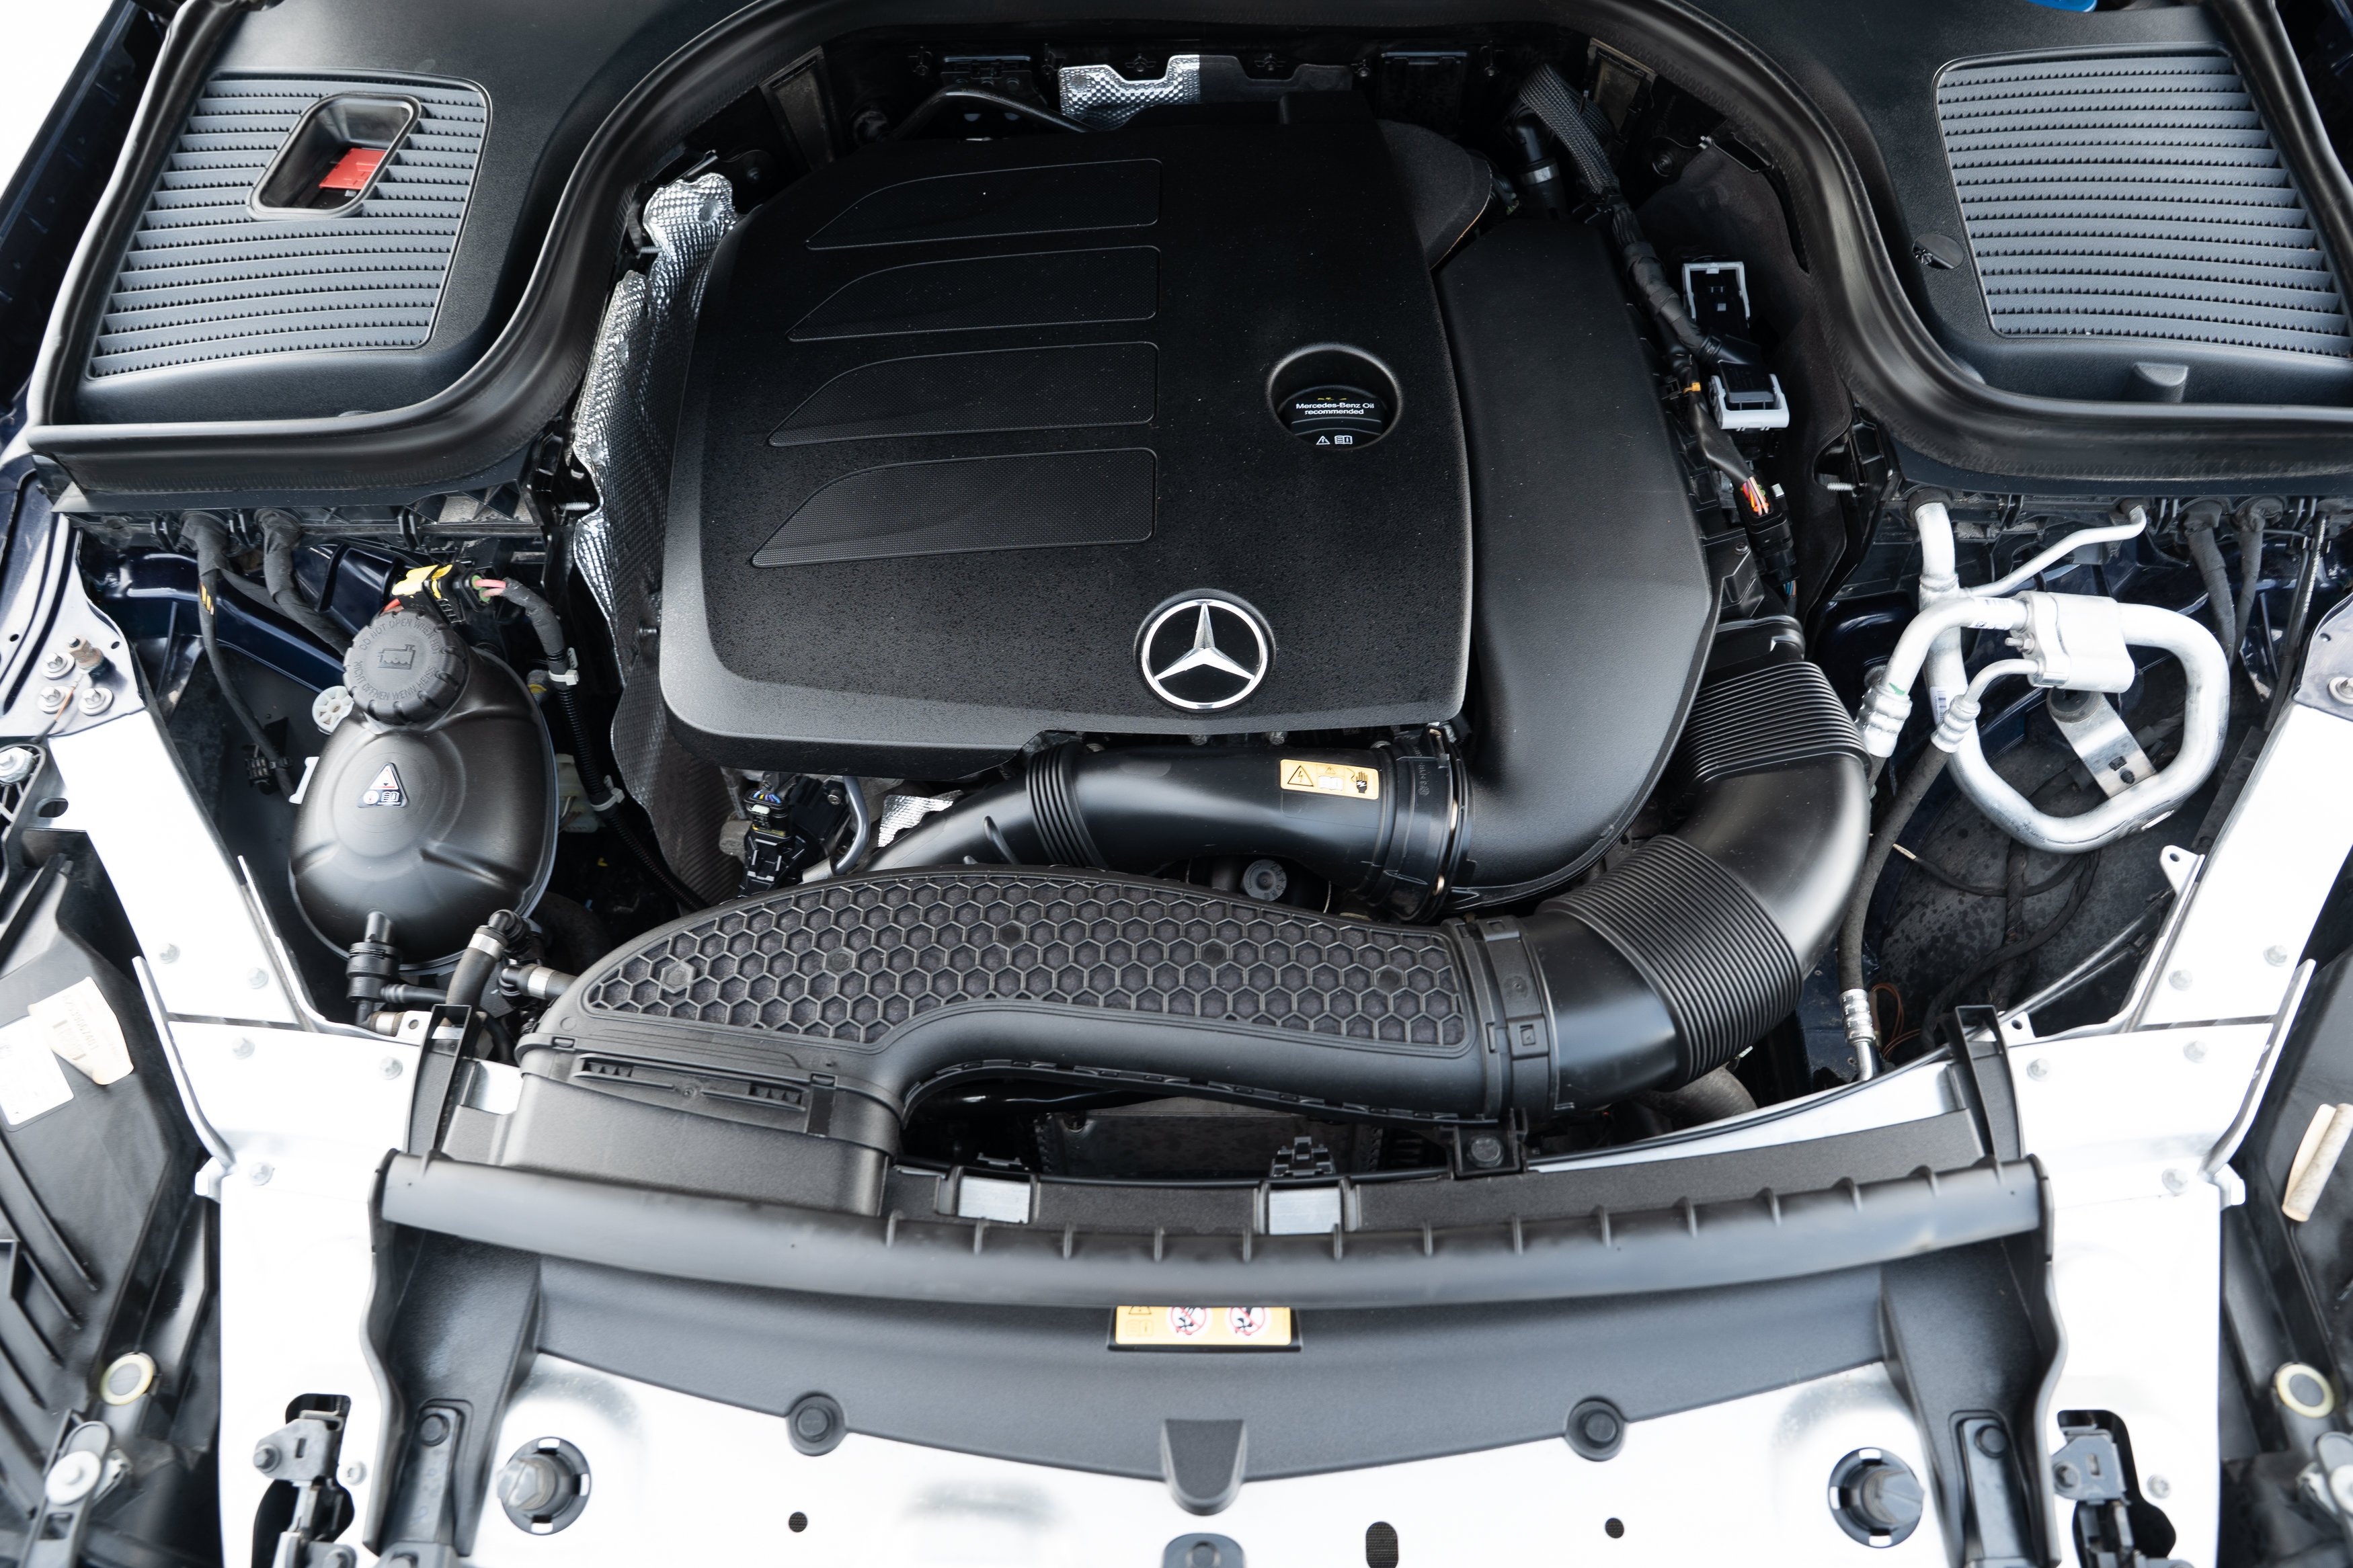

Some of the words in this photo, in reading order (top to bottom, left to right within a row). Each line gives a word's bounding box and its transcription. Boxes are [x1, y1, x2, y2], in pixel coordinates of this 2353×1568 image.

[359, 637, 372, 651] DO
[372, 623, 387, 639] NOT
[389, 618, 413, 629] OPEN
[413, 619, 436, 639] WHEN
[430, 636, 442, 655] HOT
[354, 660, 367, 684] NICHT
[392, 686, 417, 700] WENN
